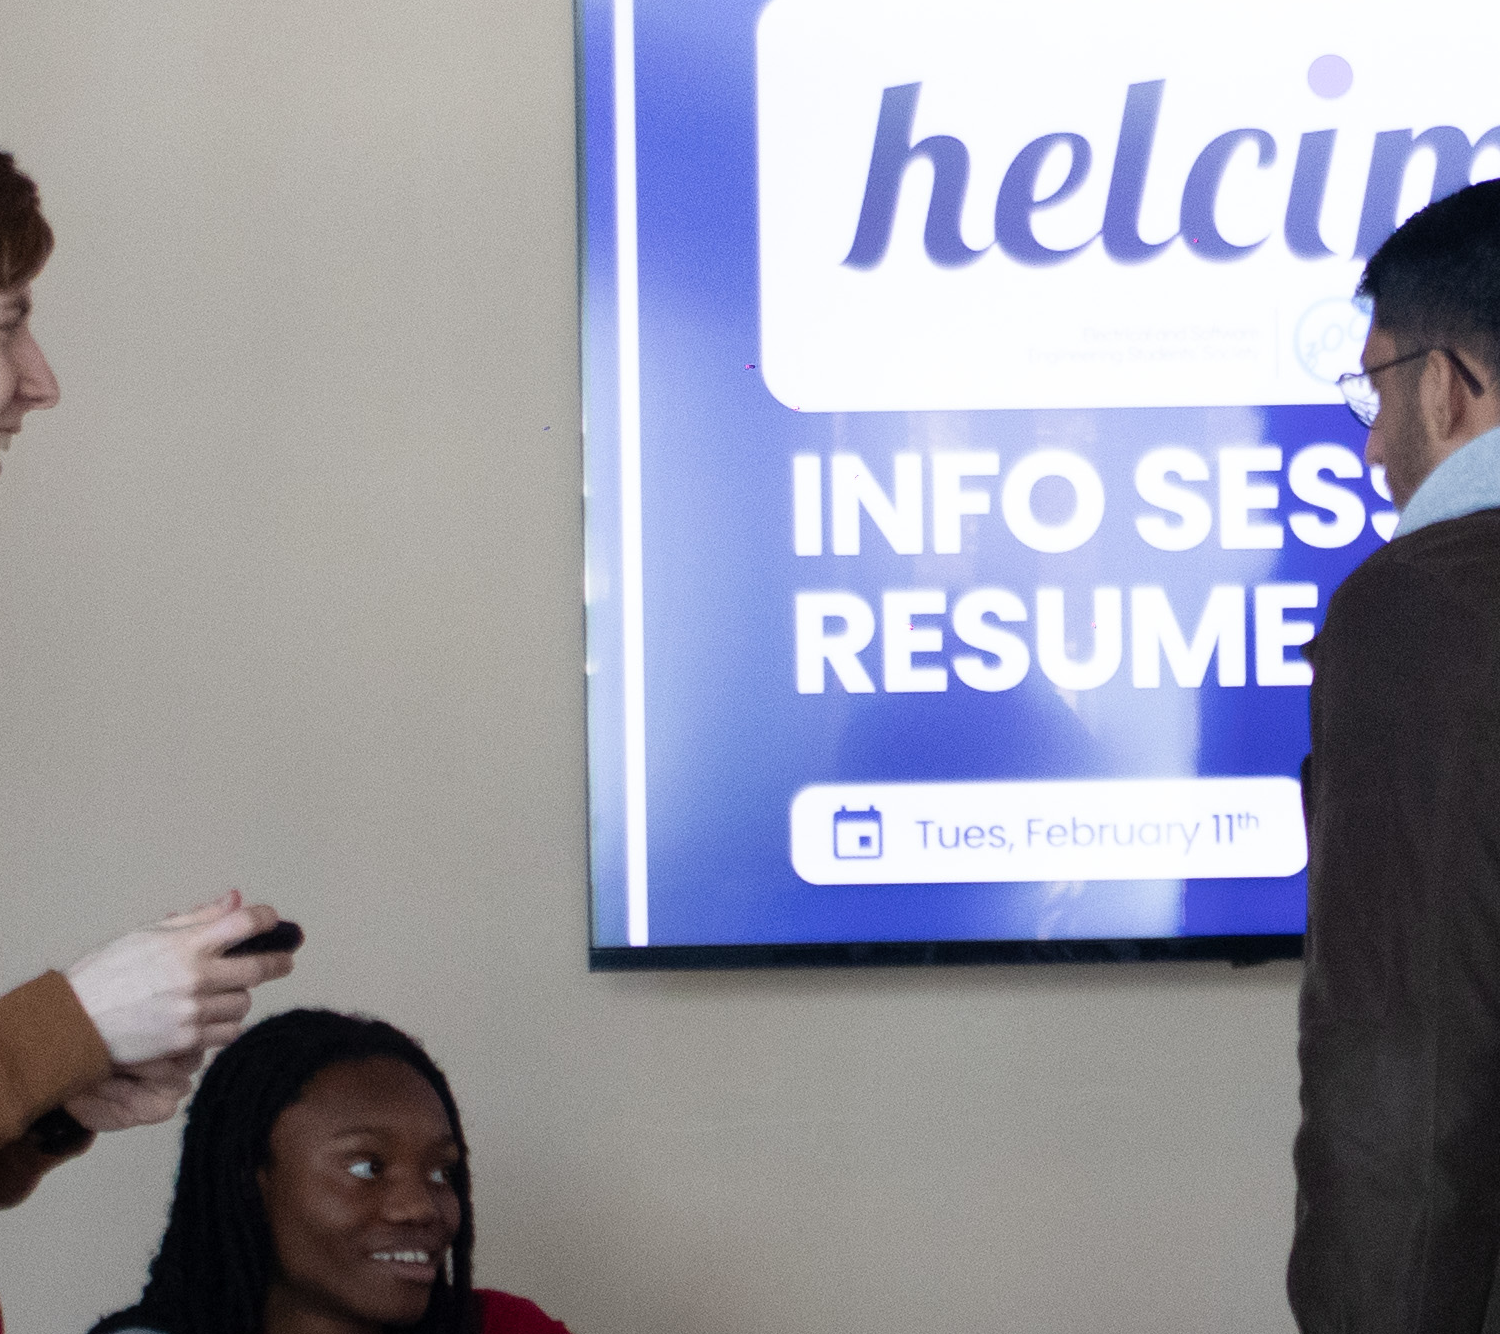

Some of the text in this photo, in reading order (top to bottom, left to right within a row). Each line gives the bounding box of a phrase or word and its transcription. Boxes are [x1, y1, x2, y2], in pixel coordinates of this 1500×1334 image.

[792, 449, 1106, 557] INFO
[1132, 442, 1400, 552] SES
[794, 583, 1320, 695] RESUME
[914, 818, 1015, 857] Tues,
[1026, 814, 1200, 859] February
